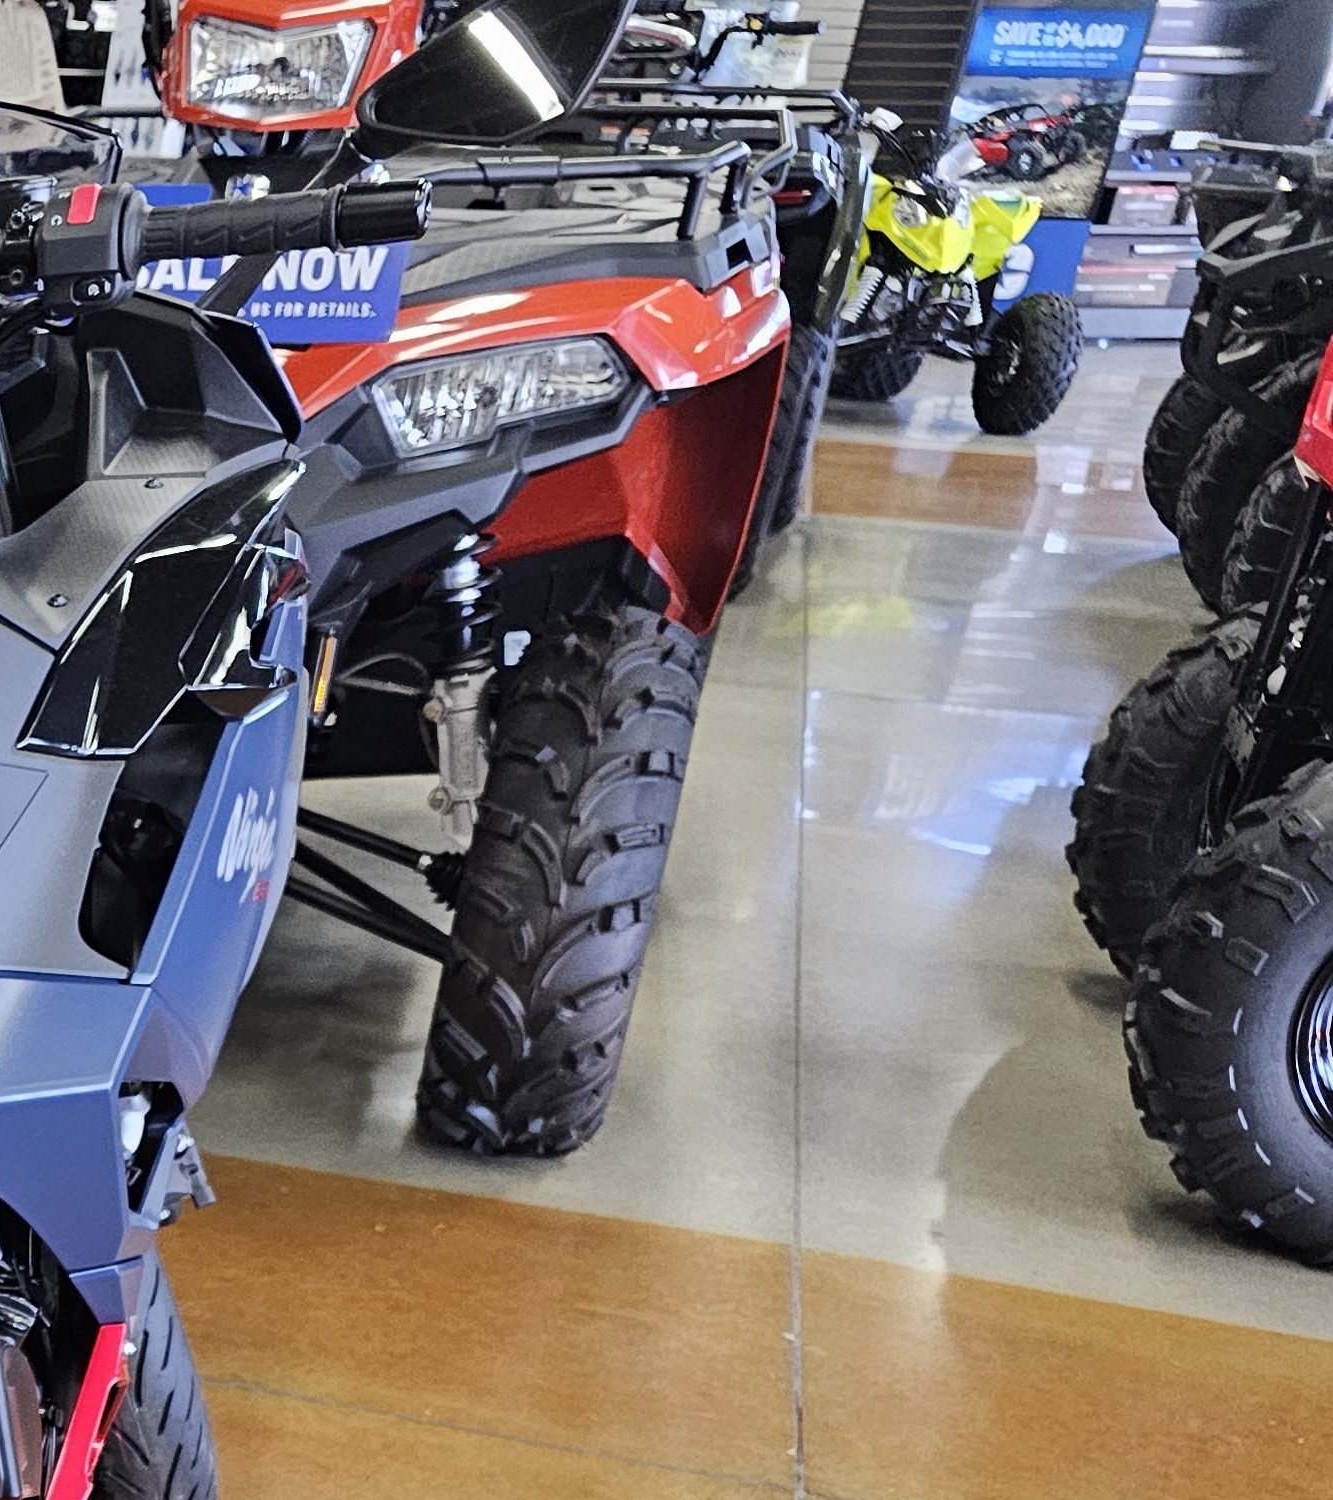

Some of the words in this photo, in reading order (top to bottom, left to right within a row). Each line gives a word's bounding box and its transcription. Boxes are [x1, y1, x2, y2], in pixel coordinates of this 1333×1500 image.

[262, 246, 389, 292] NOW
[251, 301, 272, 318] US
[274, 301, 305, 318] FOR
[216, 786, 277, 904] Ninja
